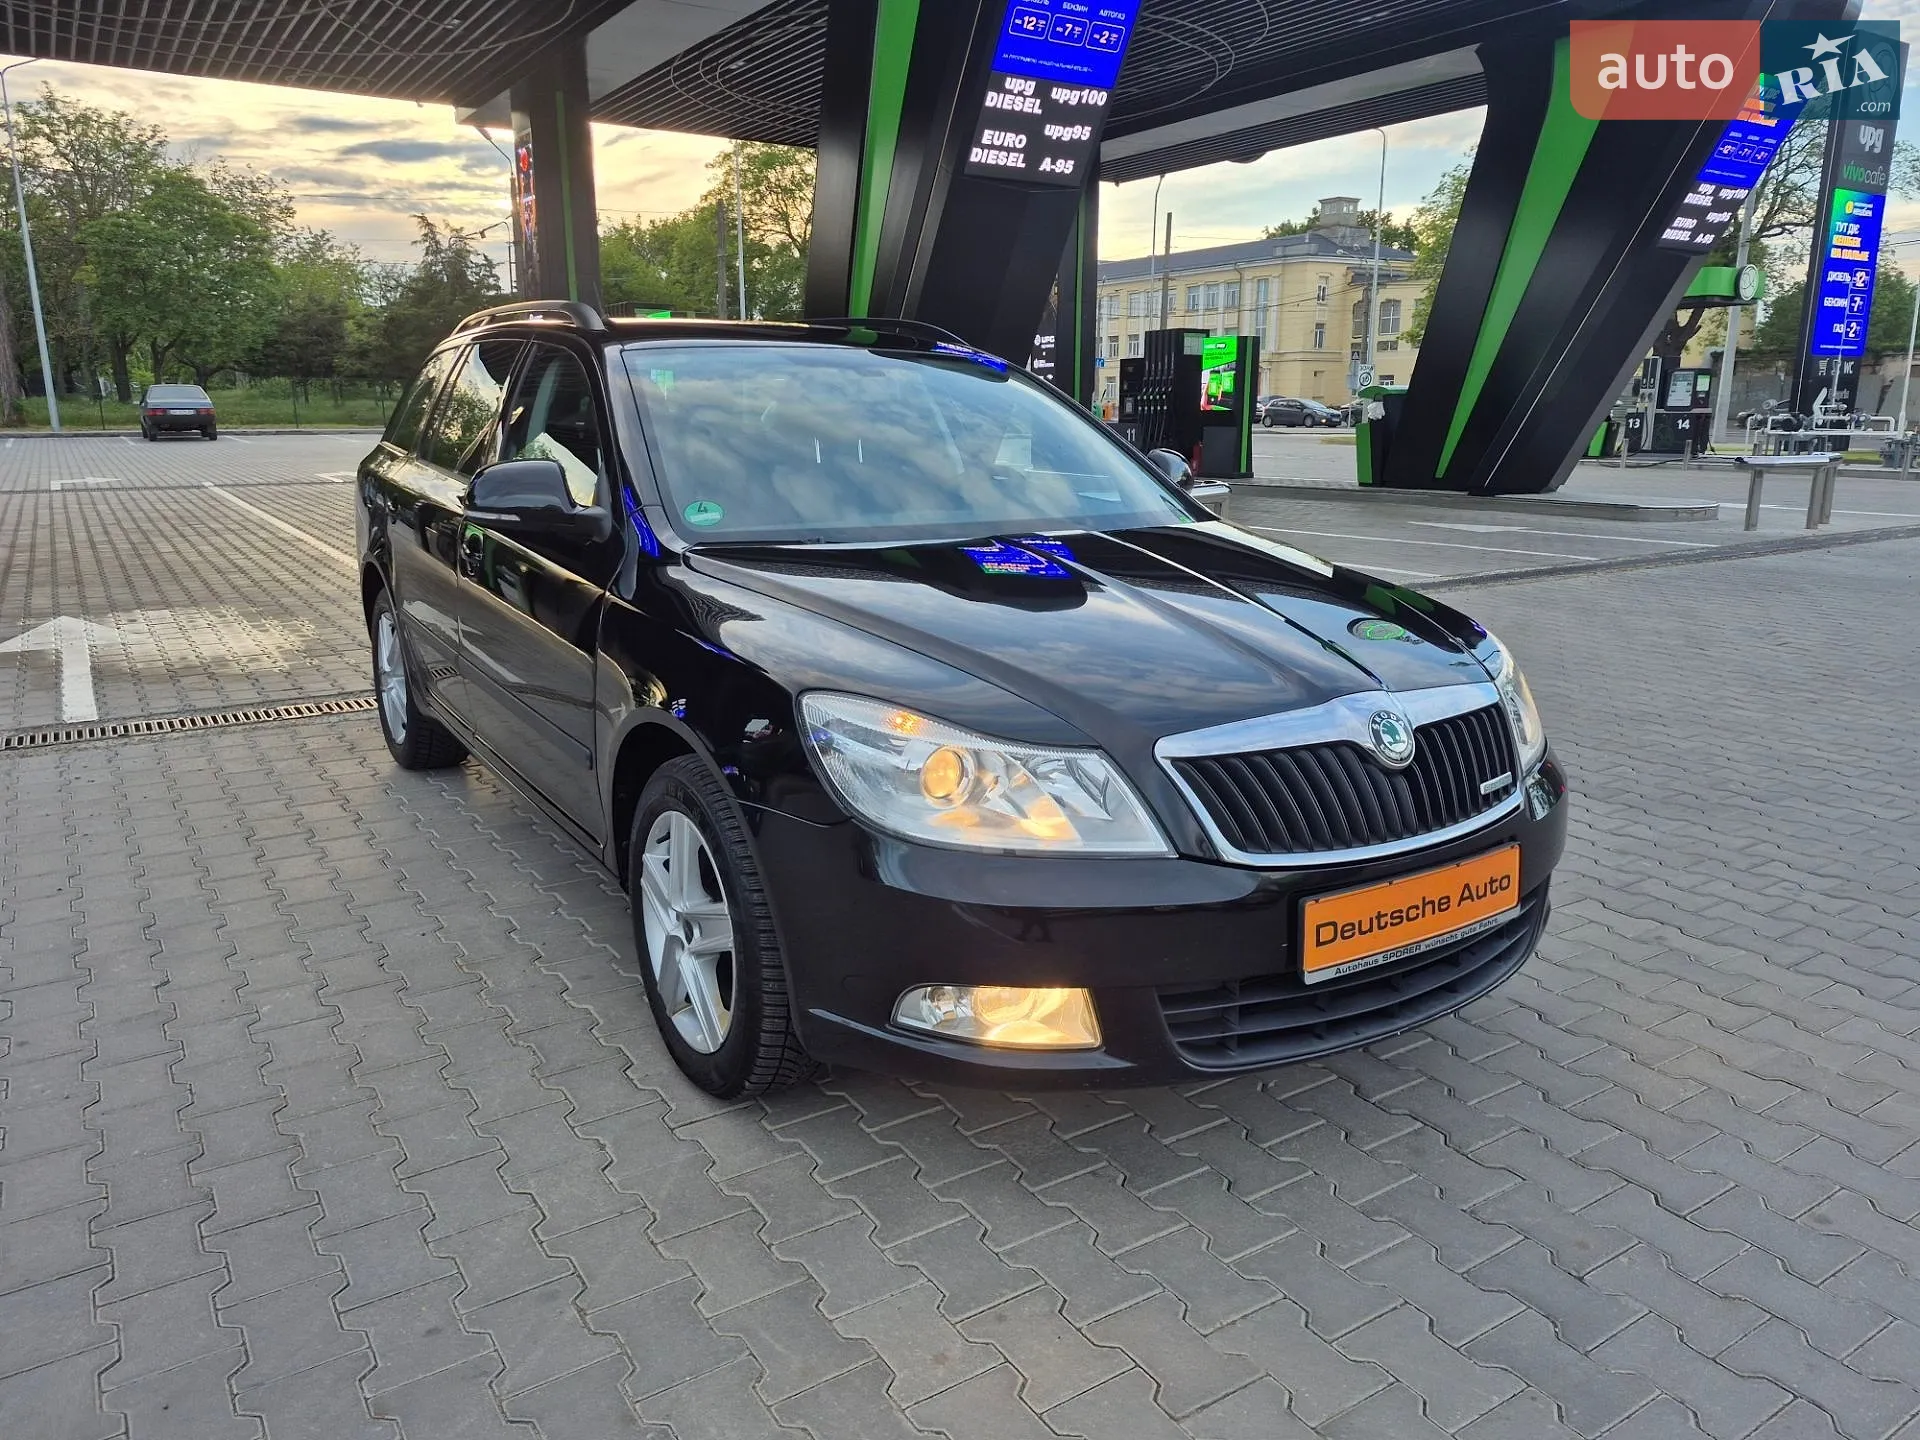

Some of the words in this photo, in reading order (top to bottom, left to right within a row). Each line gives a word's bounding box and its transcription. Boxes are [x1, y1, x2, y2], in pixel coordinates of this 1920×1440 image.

[1062, 2, 1088, 12] БЕНЗИН
[1099, 9, 1126, 20] АВТОГАЗ
[1004, 77, 1036, 96] upg
[985, 91, 1043, 115] DIESEL
[1051, 87, 1108, 106] upg100
[981, 129, 1027, 148] EURO
[1044, 124, 1092, 141] upg95
[1859, 124, 1885, 154] upg
[970, 147, 1026, 168] DIESEL
[1039, 157, 1075, 175] A-95
[1698, 183, 1716, 195] upg
[1683, 193, 1714, 206] DIESEL
[1672, 216, 1697, 229] EURO
[1661, 229, 1692, 242] DIESEL
[1628, 418, 1640, 428] 13
[1676, 419, 1690, 430] 14
[1126, 428, 1136, 441] 11
[1315, 894, 1451, 948] Deutsche
[1457, 873, 1511, 907] Auto
[1334, 958, 1379, 976] Autohaus
[1460, 926, 1477, 938] gute
